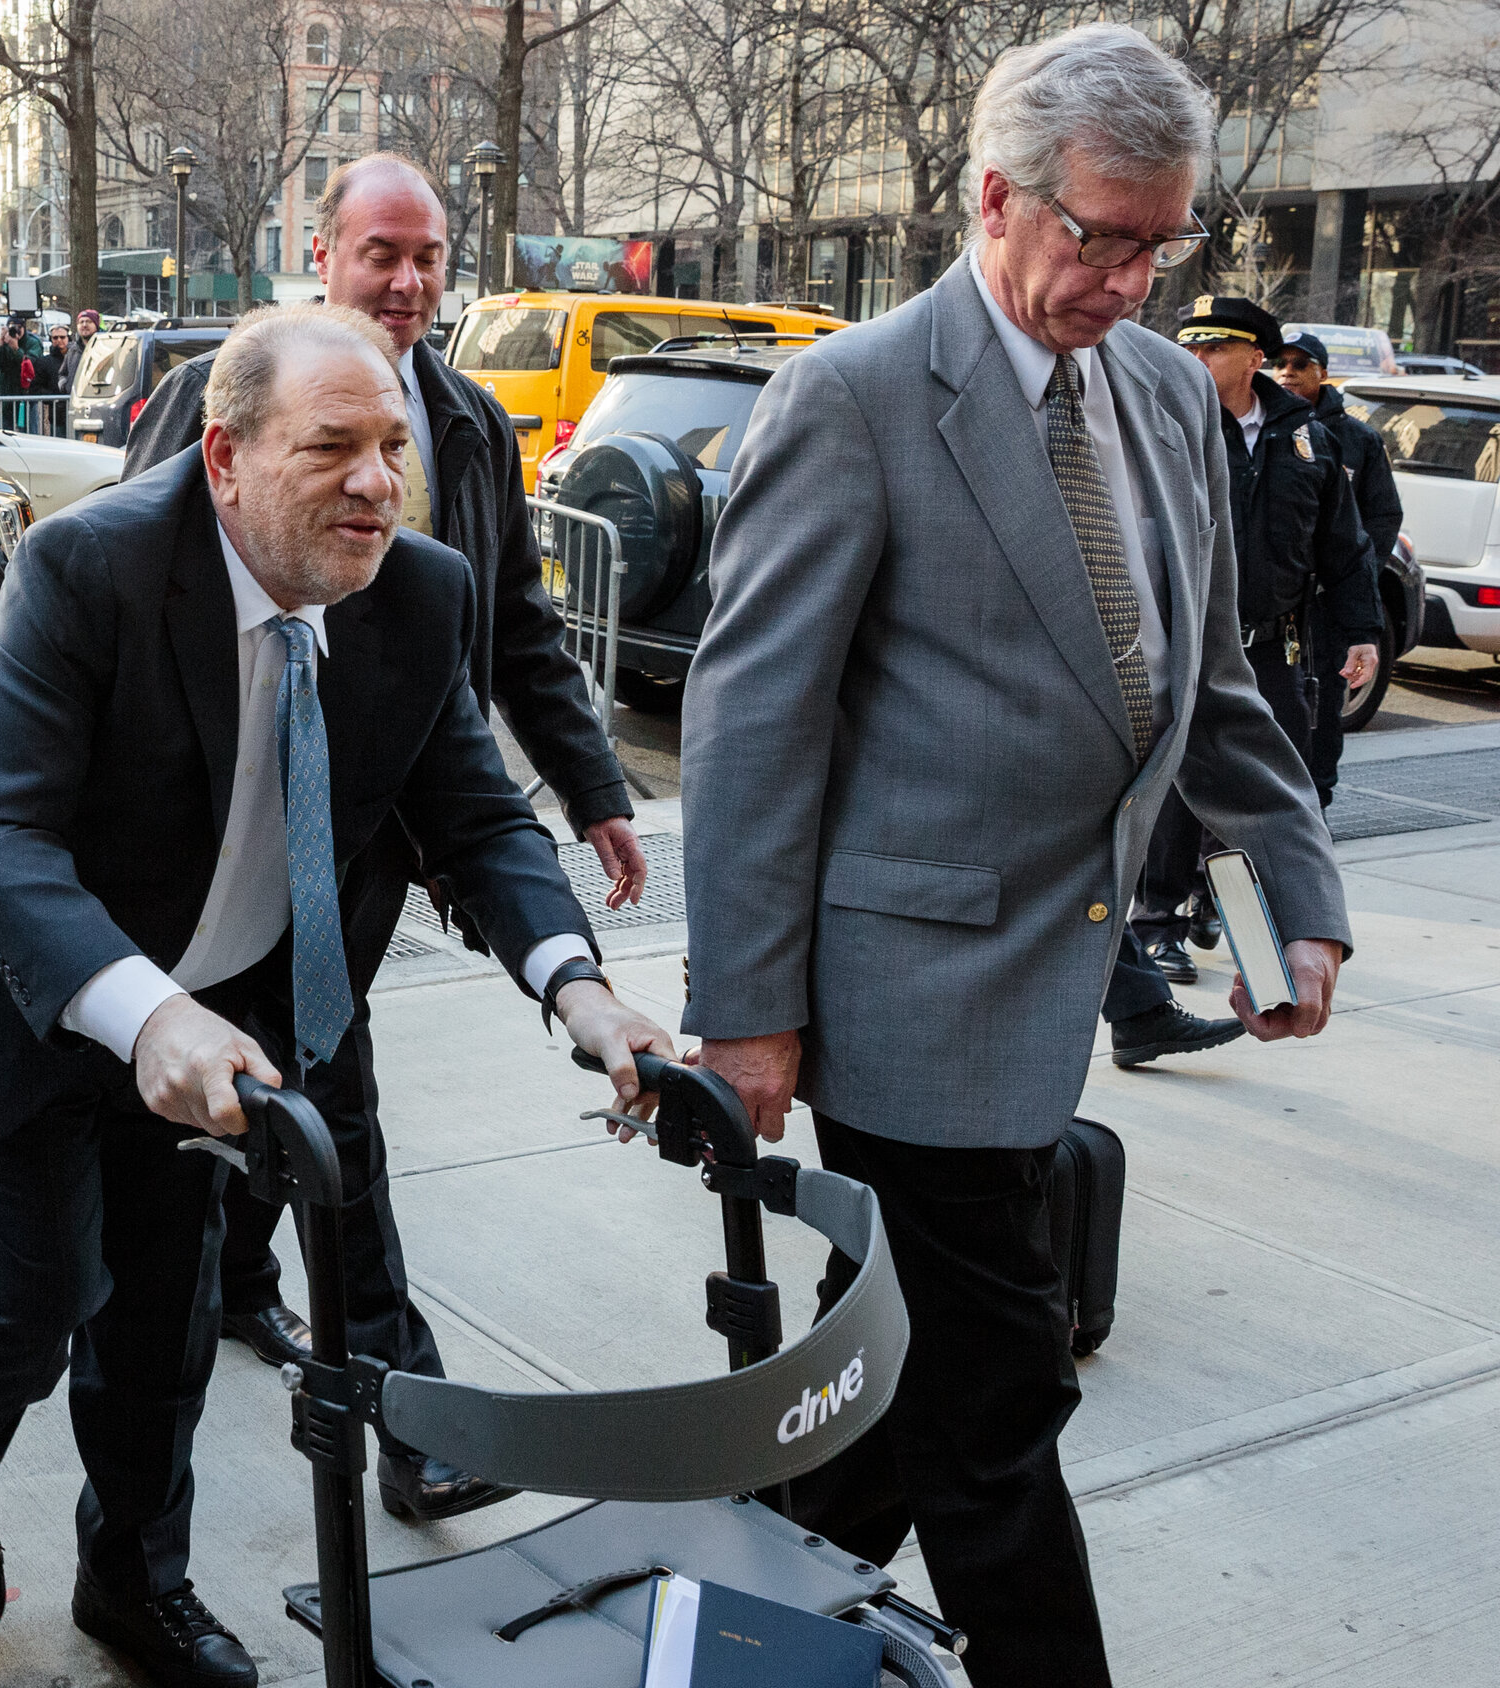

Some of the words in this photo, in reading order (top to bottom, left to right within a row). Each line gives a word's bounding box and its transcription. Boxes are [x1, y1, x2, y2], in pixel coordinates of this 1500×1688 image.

[571, 261, 599, 271] STAR
[571, 271, 599, 281] WARS
[777, 1357, 864, 1445] drive
